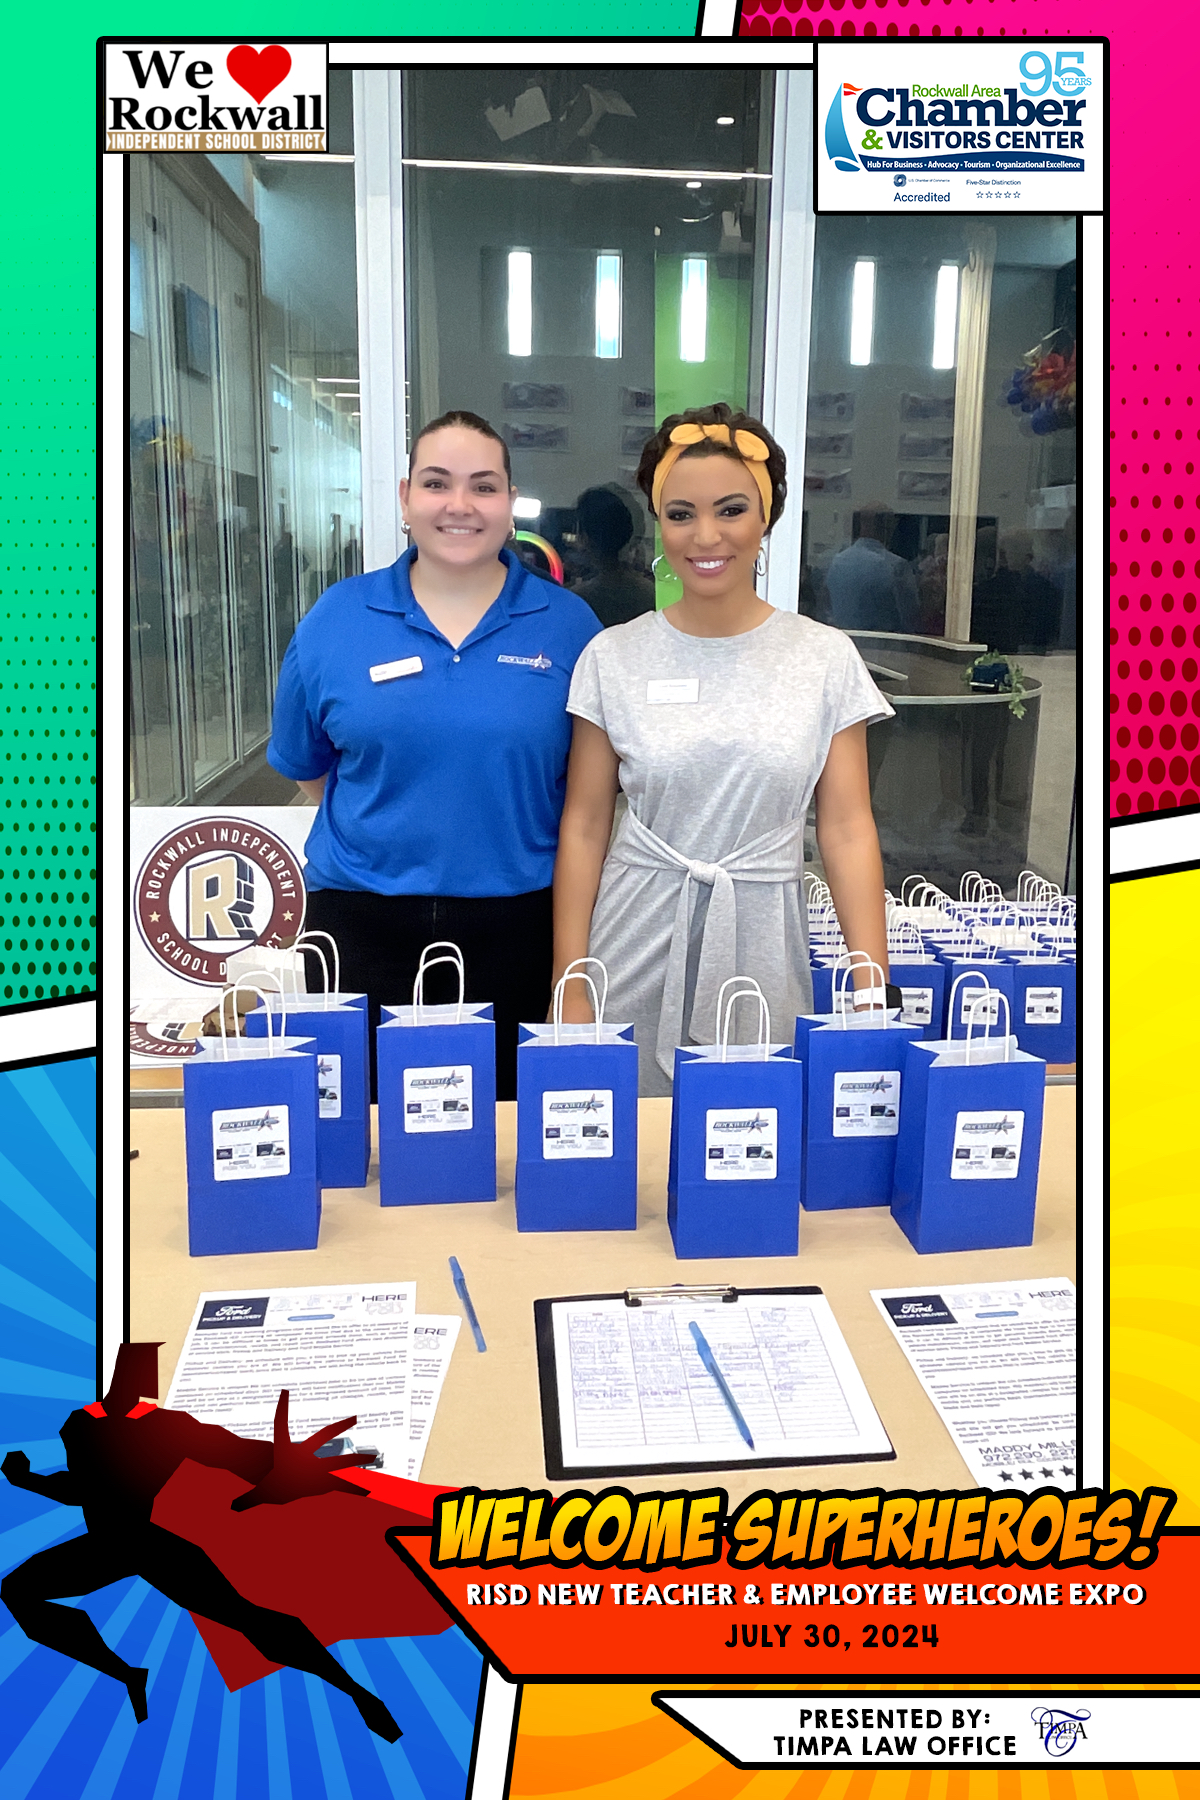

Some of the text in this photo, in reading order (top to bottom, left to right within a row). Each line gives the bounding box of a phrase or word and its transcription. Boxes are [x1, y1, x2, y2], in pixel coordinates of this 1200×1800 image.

[146, 828, 295, 899] ROCKWALL INDEPENDENT
[157, 932, 208, 975] SCHOOL
[361, 1293, 407, 1303] HERE
[1028, 1289, 1074, 1299] HERE
[215, 1305, 252, 1316] Ford
[901, 1303, 933, 1314] Ford
[413, 1326, 448, 1336] ERE
[978, 1443, 1032, 1455] MADDY
